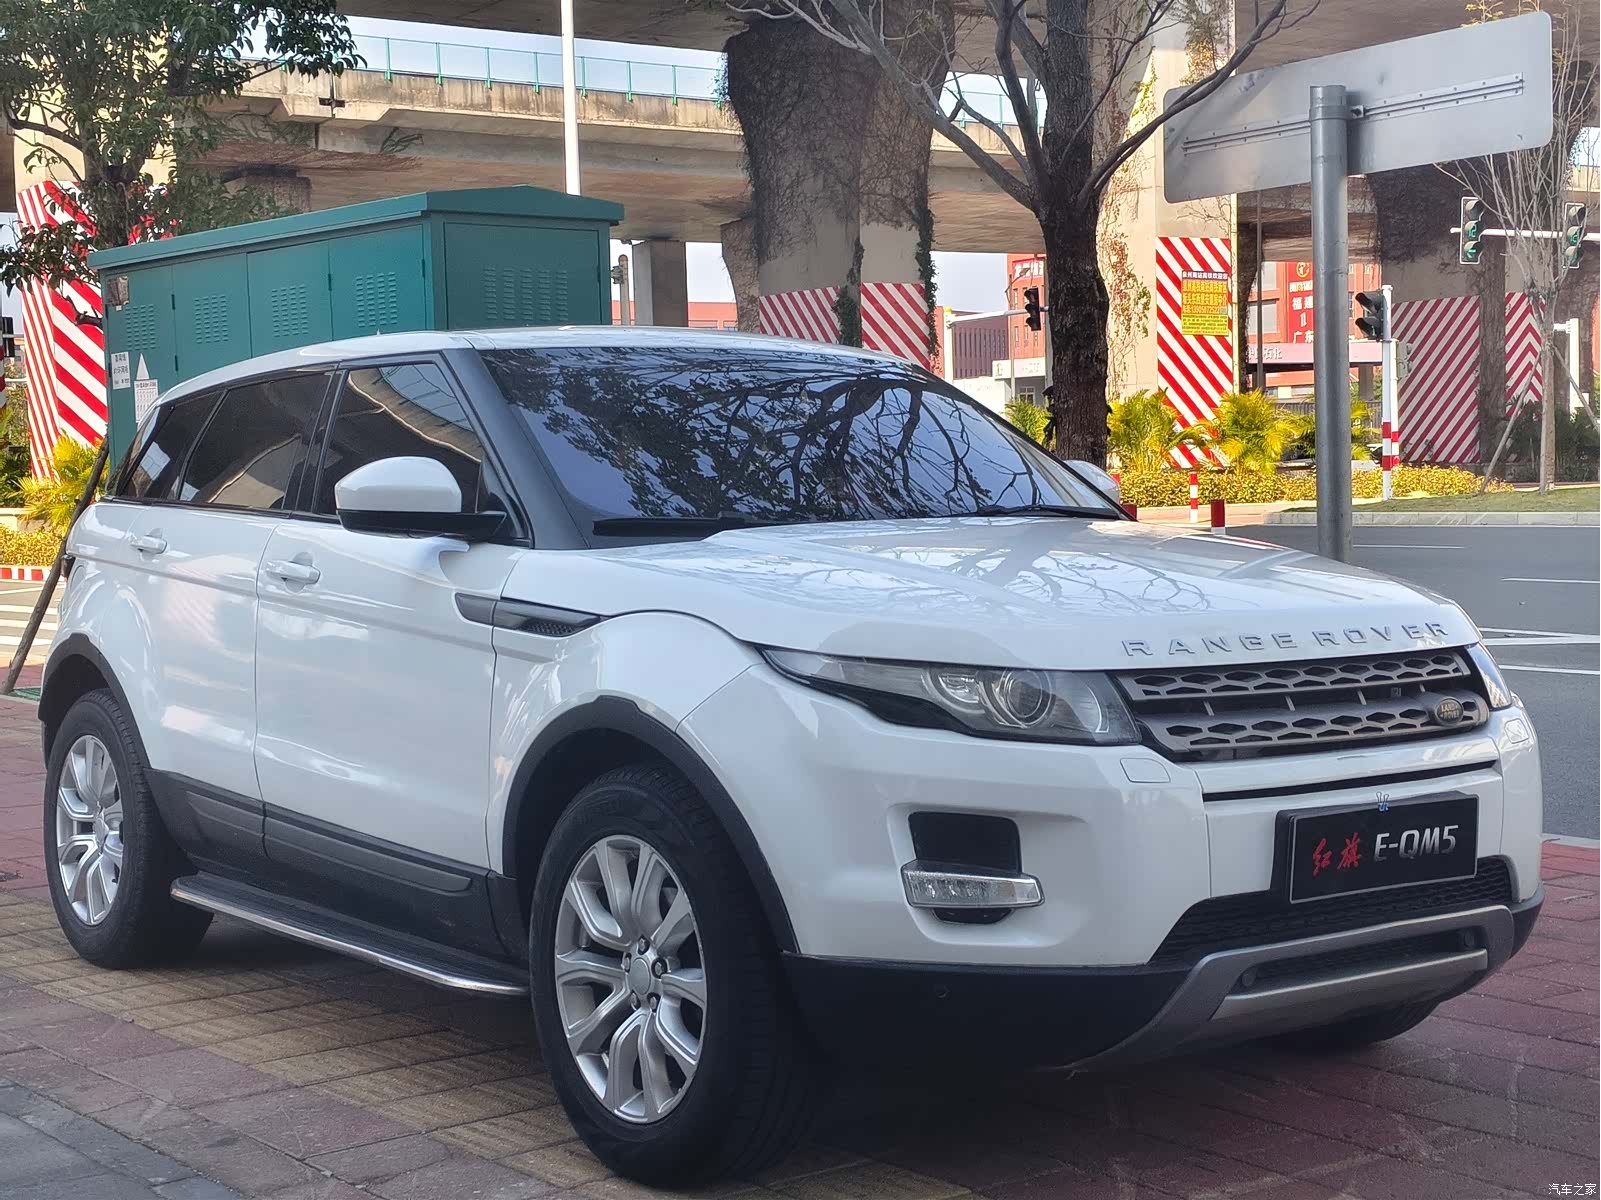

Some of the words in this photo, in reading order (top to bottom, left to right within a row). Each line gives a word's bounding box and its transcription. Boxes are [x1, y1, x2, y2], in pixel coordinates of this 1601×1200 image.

[1121, 632, 1298, 657] RANGE
[1312, 622, 1449, 647] ROVER
[1312, 832, 1362, 877] 红旗
[1374, 825, 1459, 862] E-QM5
